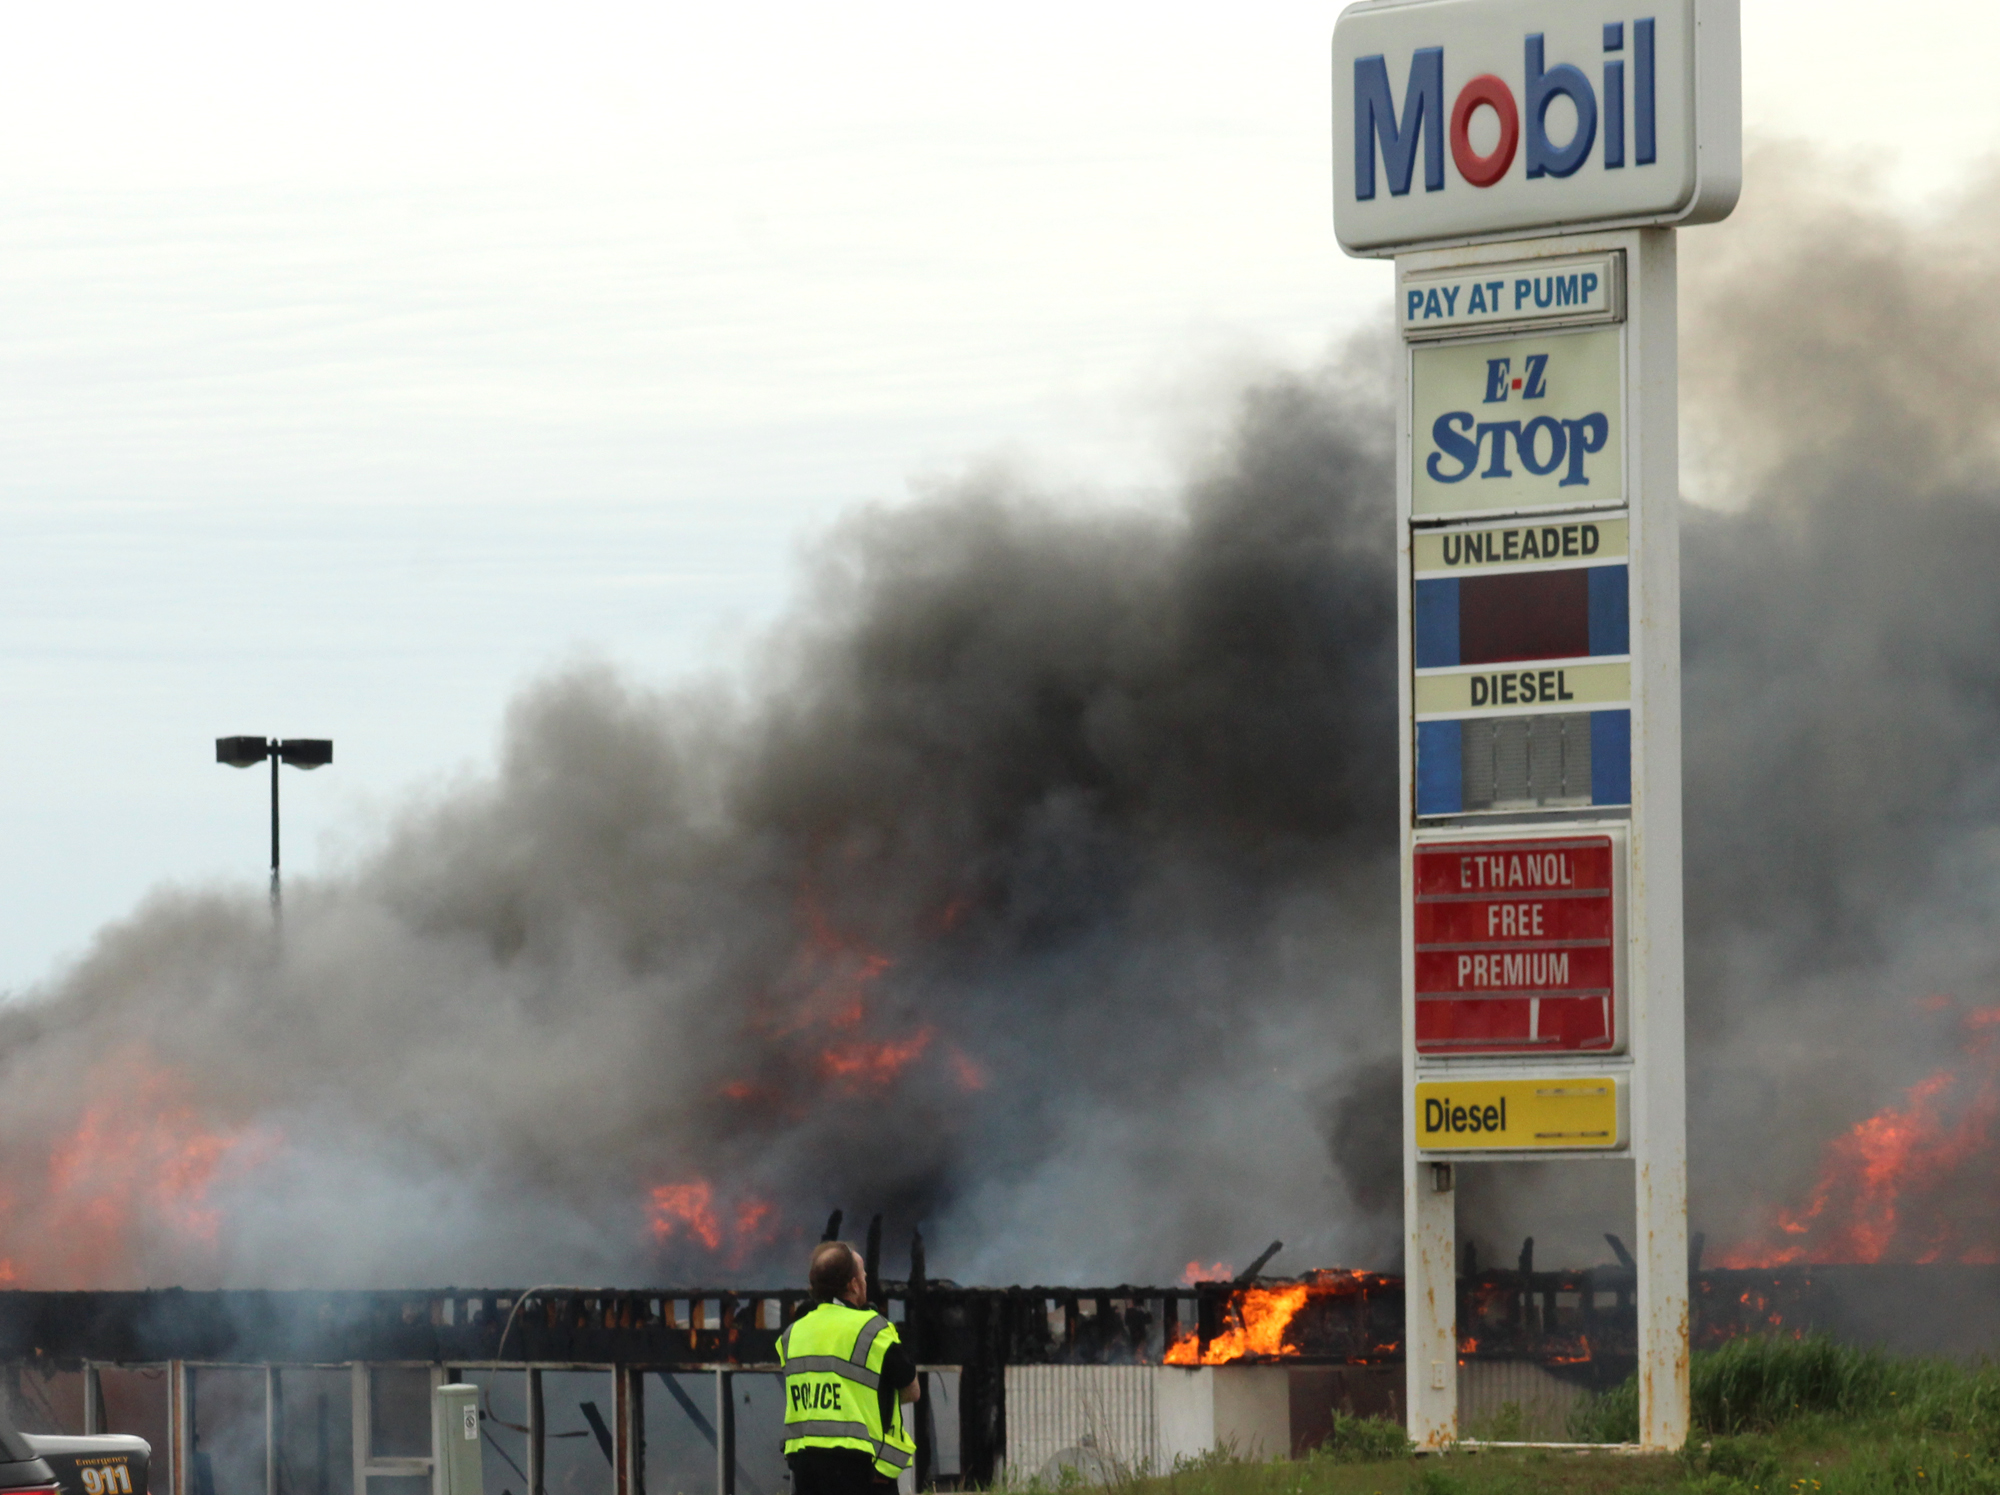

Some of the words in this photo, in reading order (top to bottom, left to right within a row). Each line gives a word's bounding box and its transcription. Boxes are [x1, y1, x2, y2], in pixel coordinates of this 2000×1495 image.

[1354, 17, 1656, 202] Mobil
[1407, 285, 1461, 321] PAY
[1468, 281, 1504, 314] AT
[1514, 272, 1598, 310] PUMP
[1482, 353, 1549, 404] E-Z
[1442, 524, 1600, 566] UNLEADED
[1470, 670, 1574, 707] DIESEL
[1461, 853, 1571, 889] ETHANOL
[1488, 904, 1544, 937] FREE
[1458, 952, 1569, 987] PREMIUM
[1425, 1097, 1507, 1133] Diesel
[790, 1382, 842, 1411] POLICE
[75, 1456, 129, 1466] Emergency
[81, 1464, 133, 1495] 911
